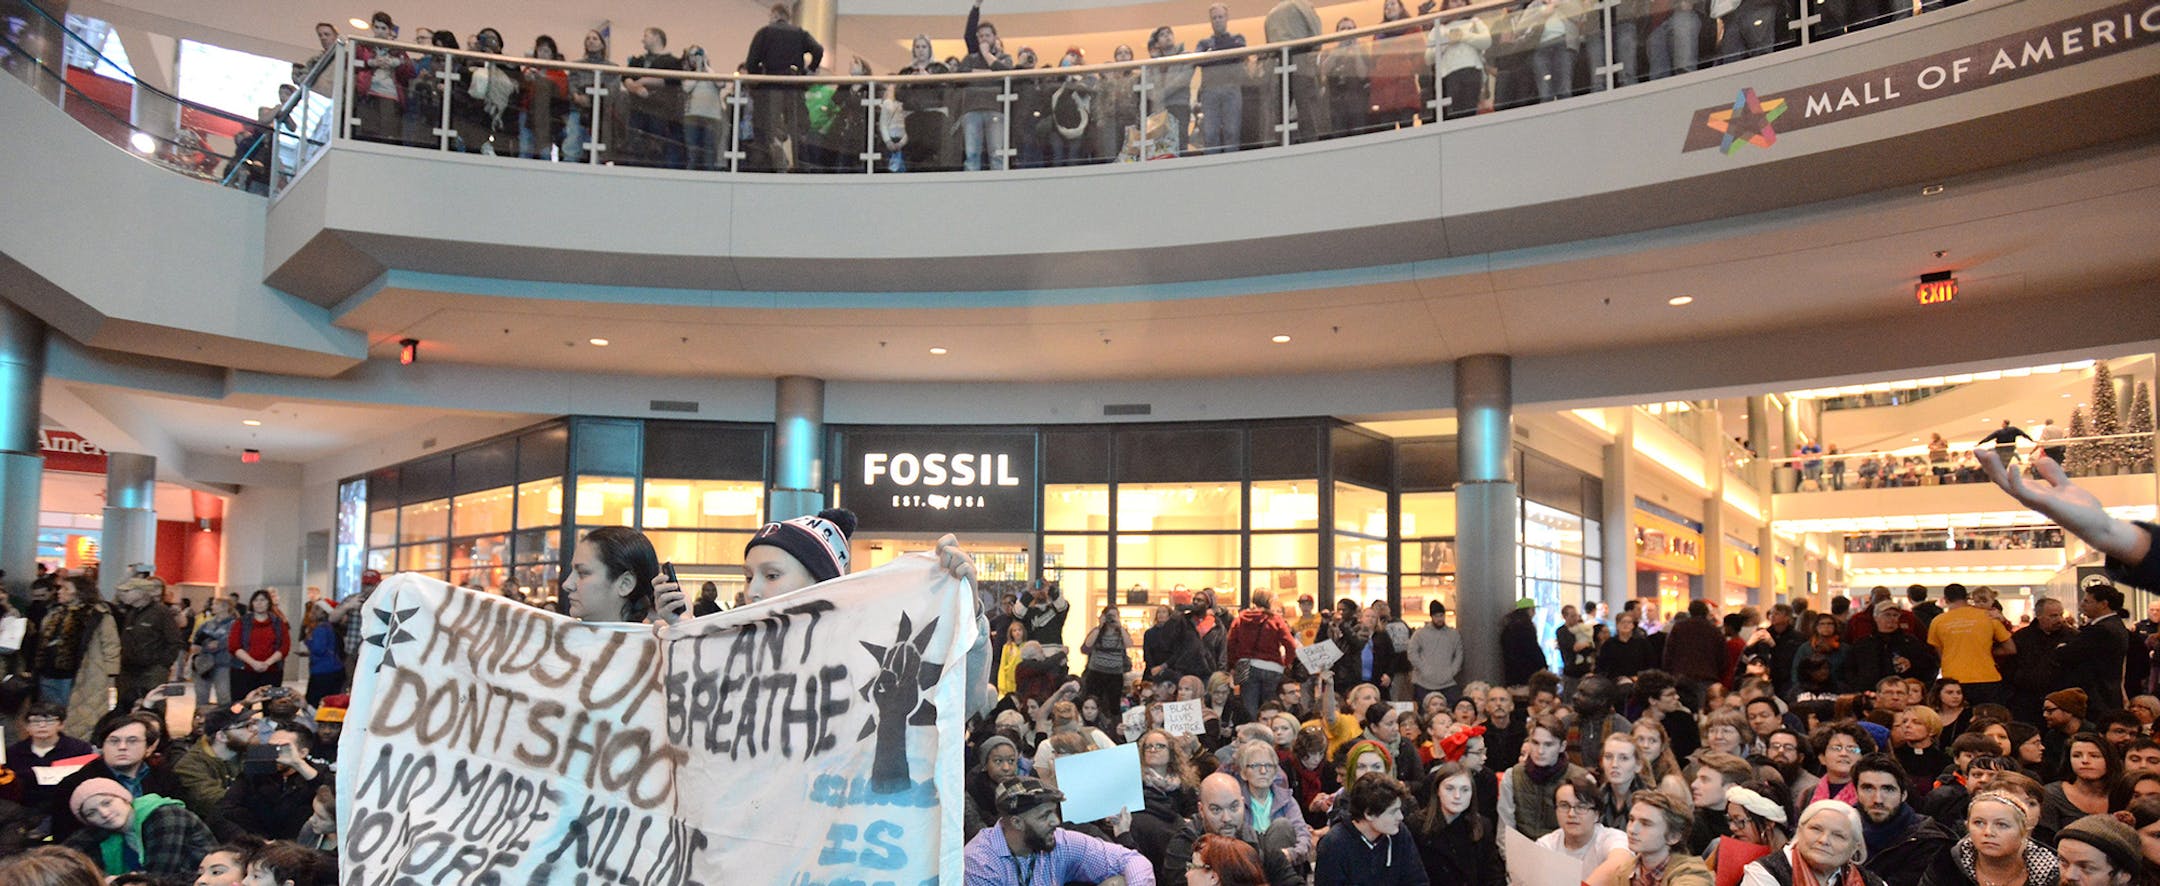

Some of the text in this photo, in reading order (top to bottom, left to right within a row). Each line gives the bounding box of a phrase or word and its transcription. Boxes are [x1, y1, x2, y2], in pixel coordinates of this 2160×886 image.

[1804, 77, 1900, 118] MALL
[1917, 57, 1971, 90] OF
[1919, 281, 1953, 304] EXIT
[864, 453, 1019, 486] FOSSIL
[892, 495, 985, 508] EST. USA
[420, 585, 599, 688] HANDS
[369, 667, 529, 754] DONT
[665, 663, 850, 762] BREATHE
[356, 743, 436, 813] NO
[426, 758, 567, 851] MORE
[817, 819, 908, 870] IS
